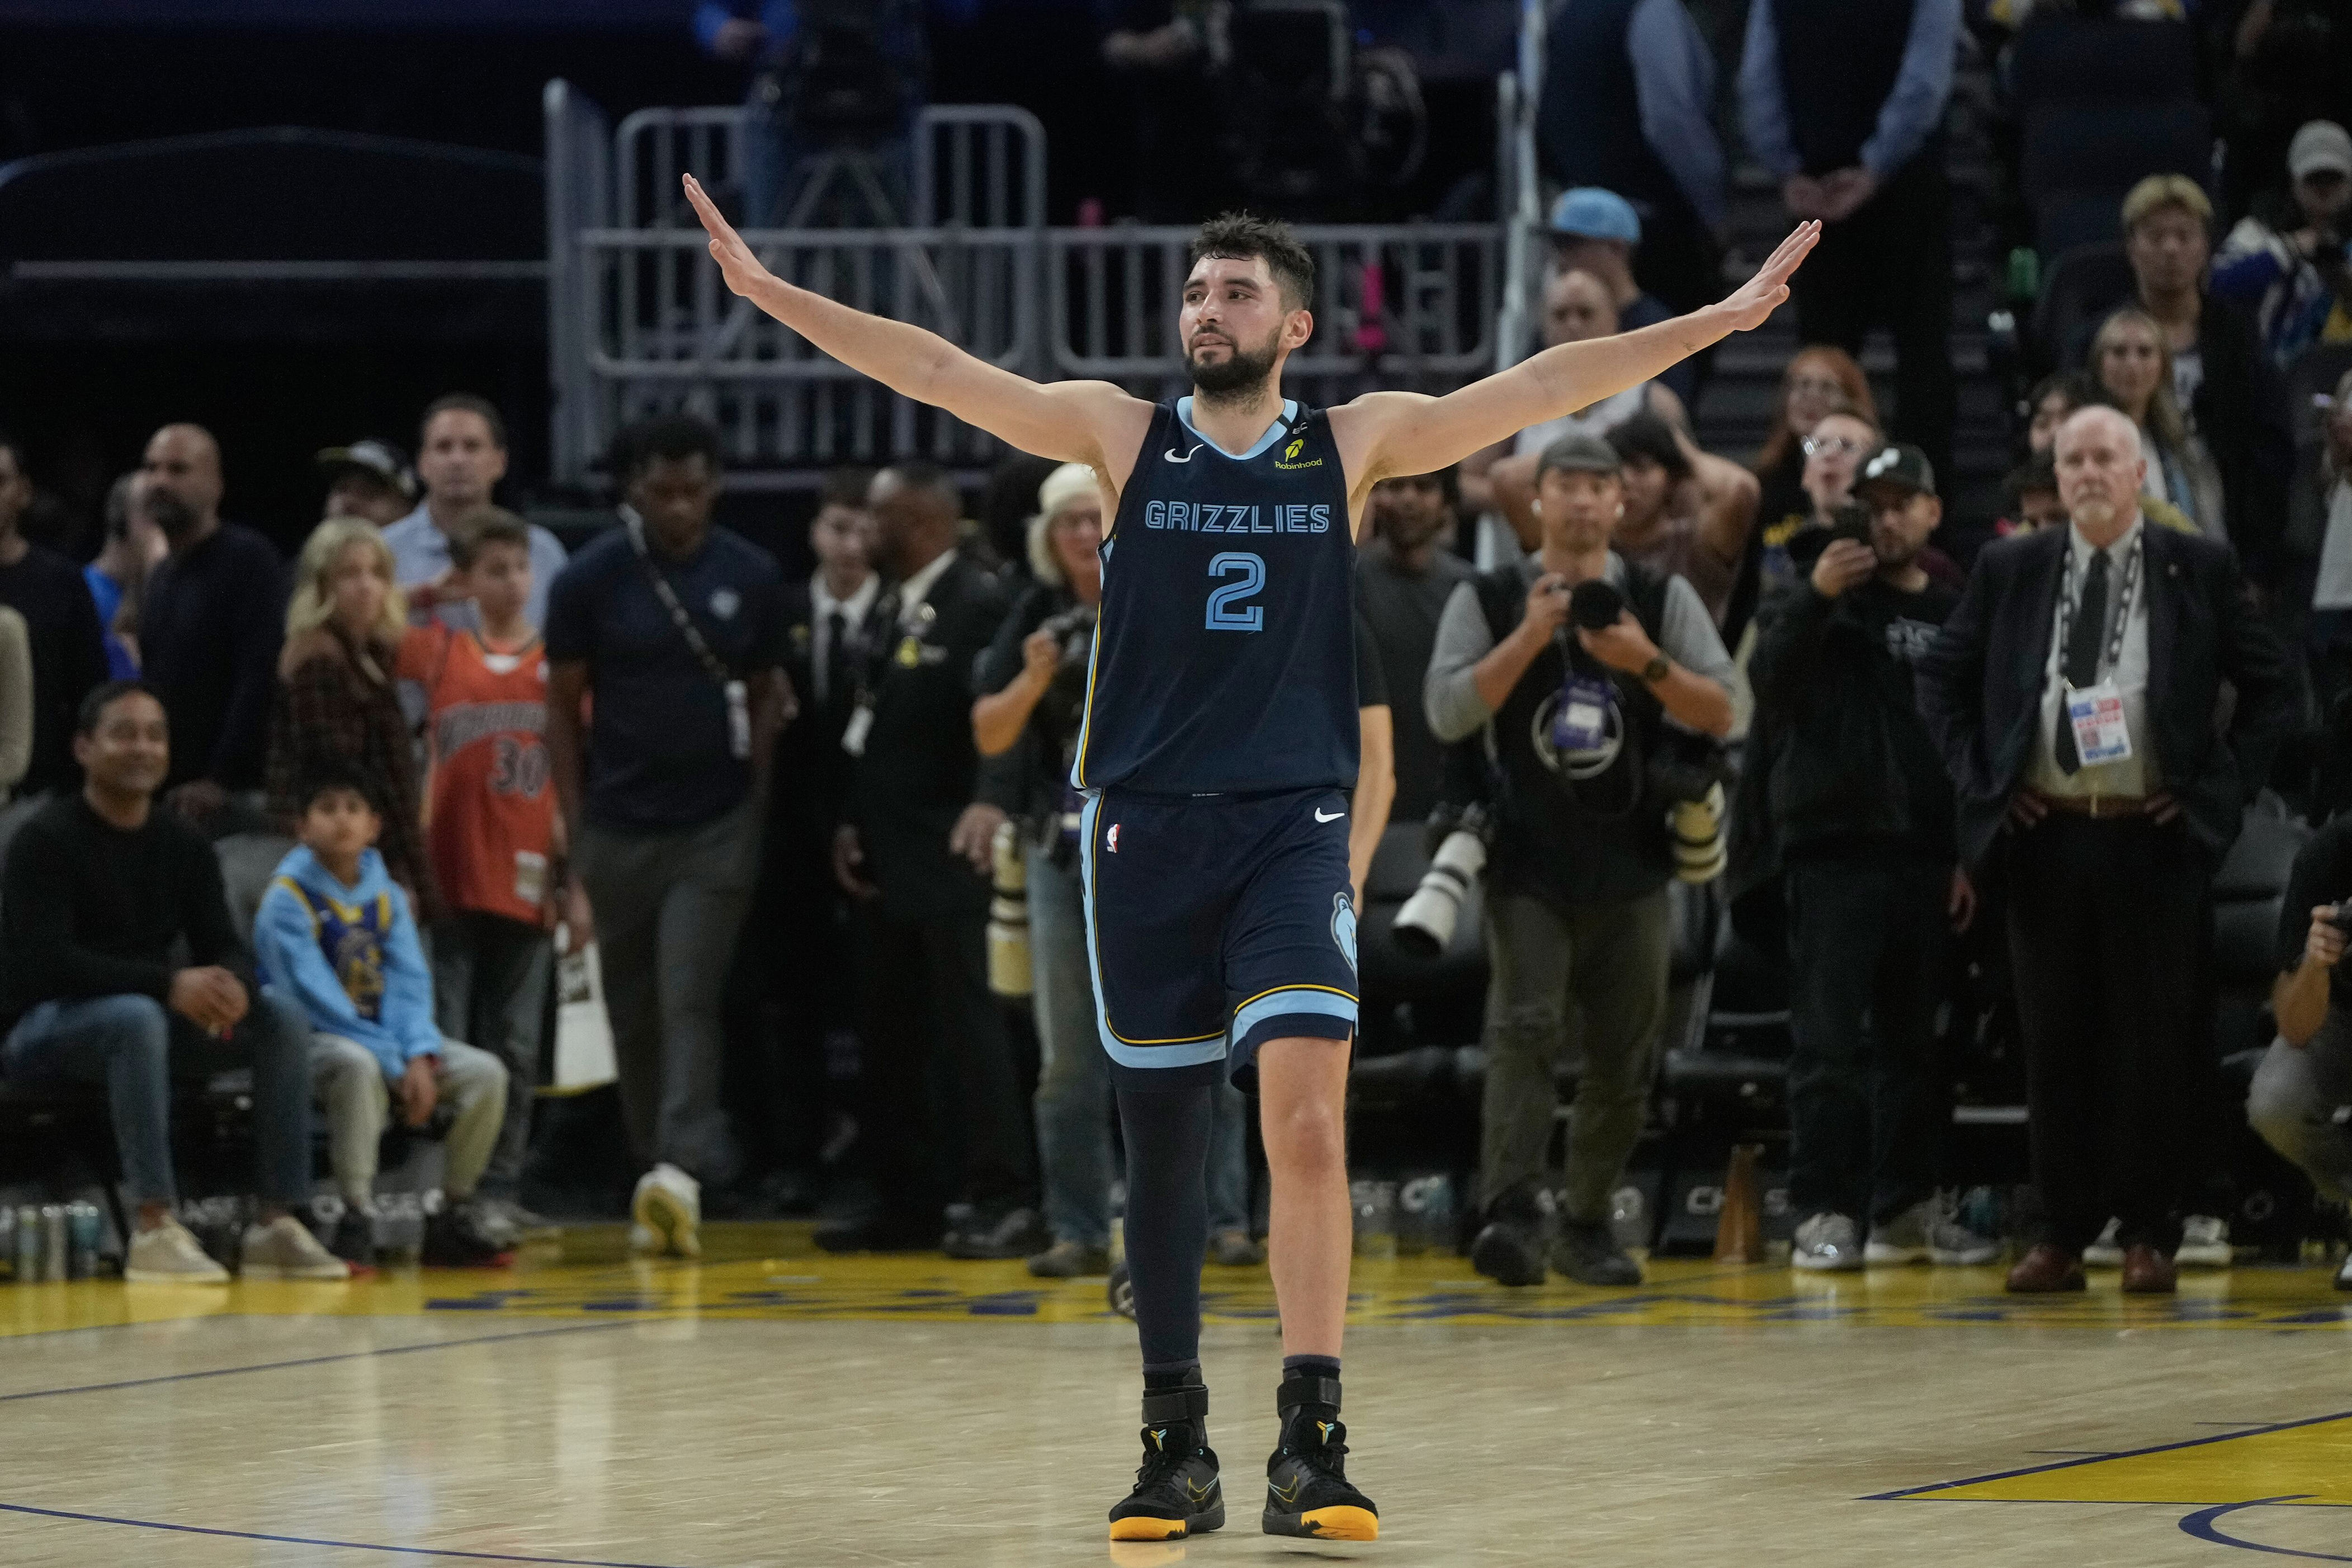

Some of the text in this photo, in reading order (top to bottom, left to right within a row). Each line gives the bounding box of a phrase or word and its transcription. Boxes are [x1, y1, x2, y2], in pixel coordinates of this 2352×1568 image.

[1275, 458, 1323, 469] Robinhood
[1145, 500, 1329, 533] GRIZZLIES
[1205, 551, 1265, 631] 2
